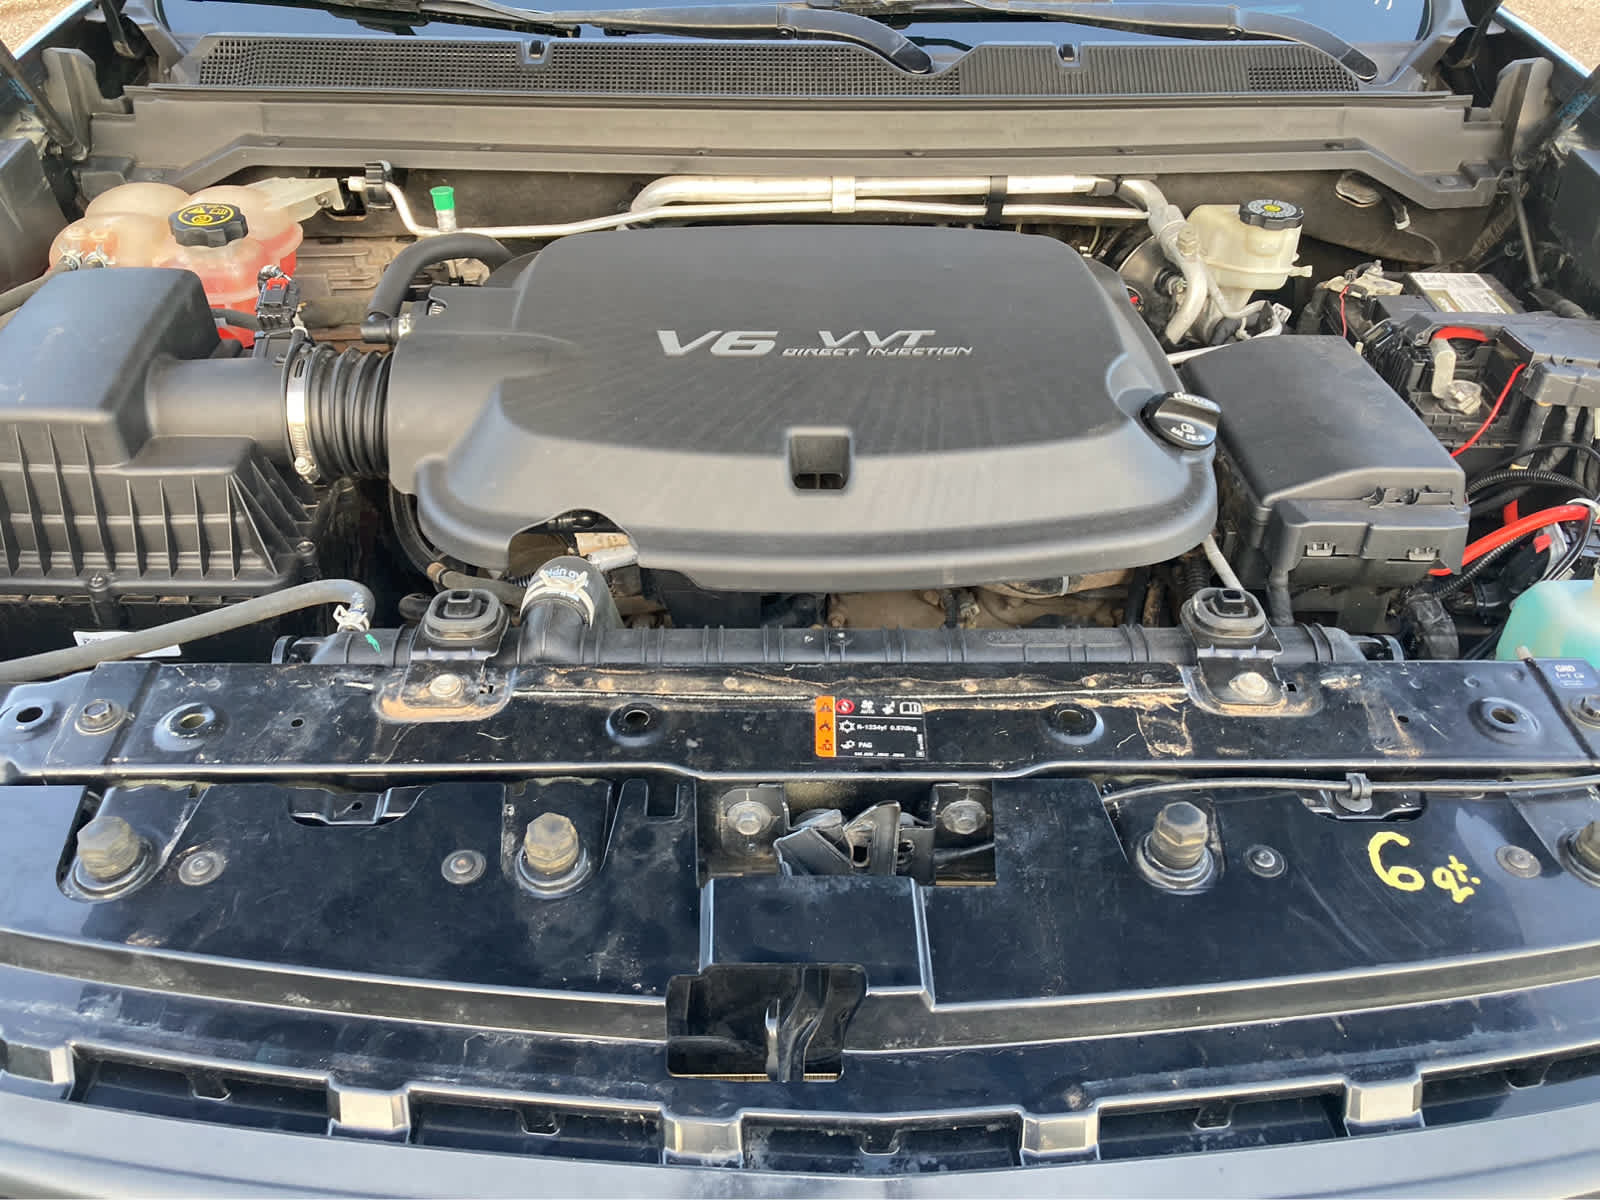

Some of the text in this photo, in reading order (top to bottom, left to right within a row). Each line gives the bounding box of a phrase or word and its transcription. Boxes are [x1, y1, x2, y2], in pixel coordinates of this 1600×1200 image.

[656, 329, 937, 357] V6 VVT
[782, 346, 974, 357] DIRECT INJECTION
[1367, 831, 1426, 892] 6
